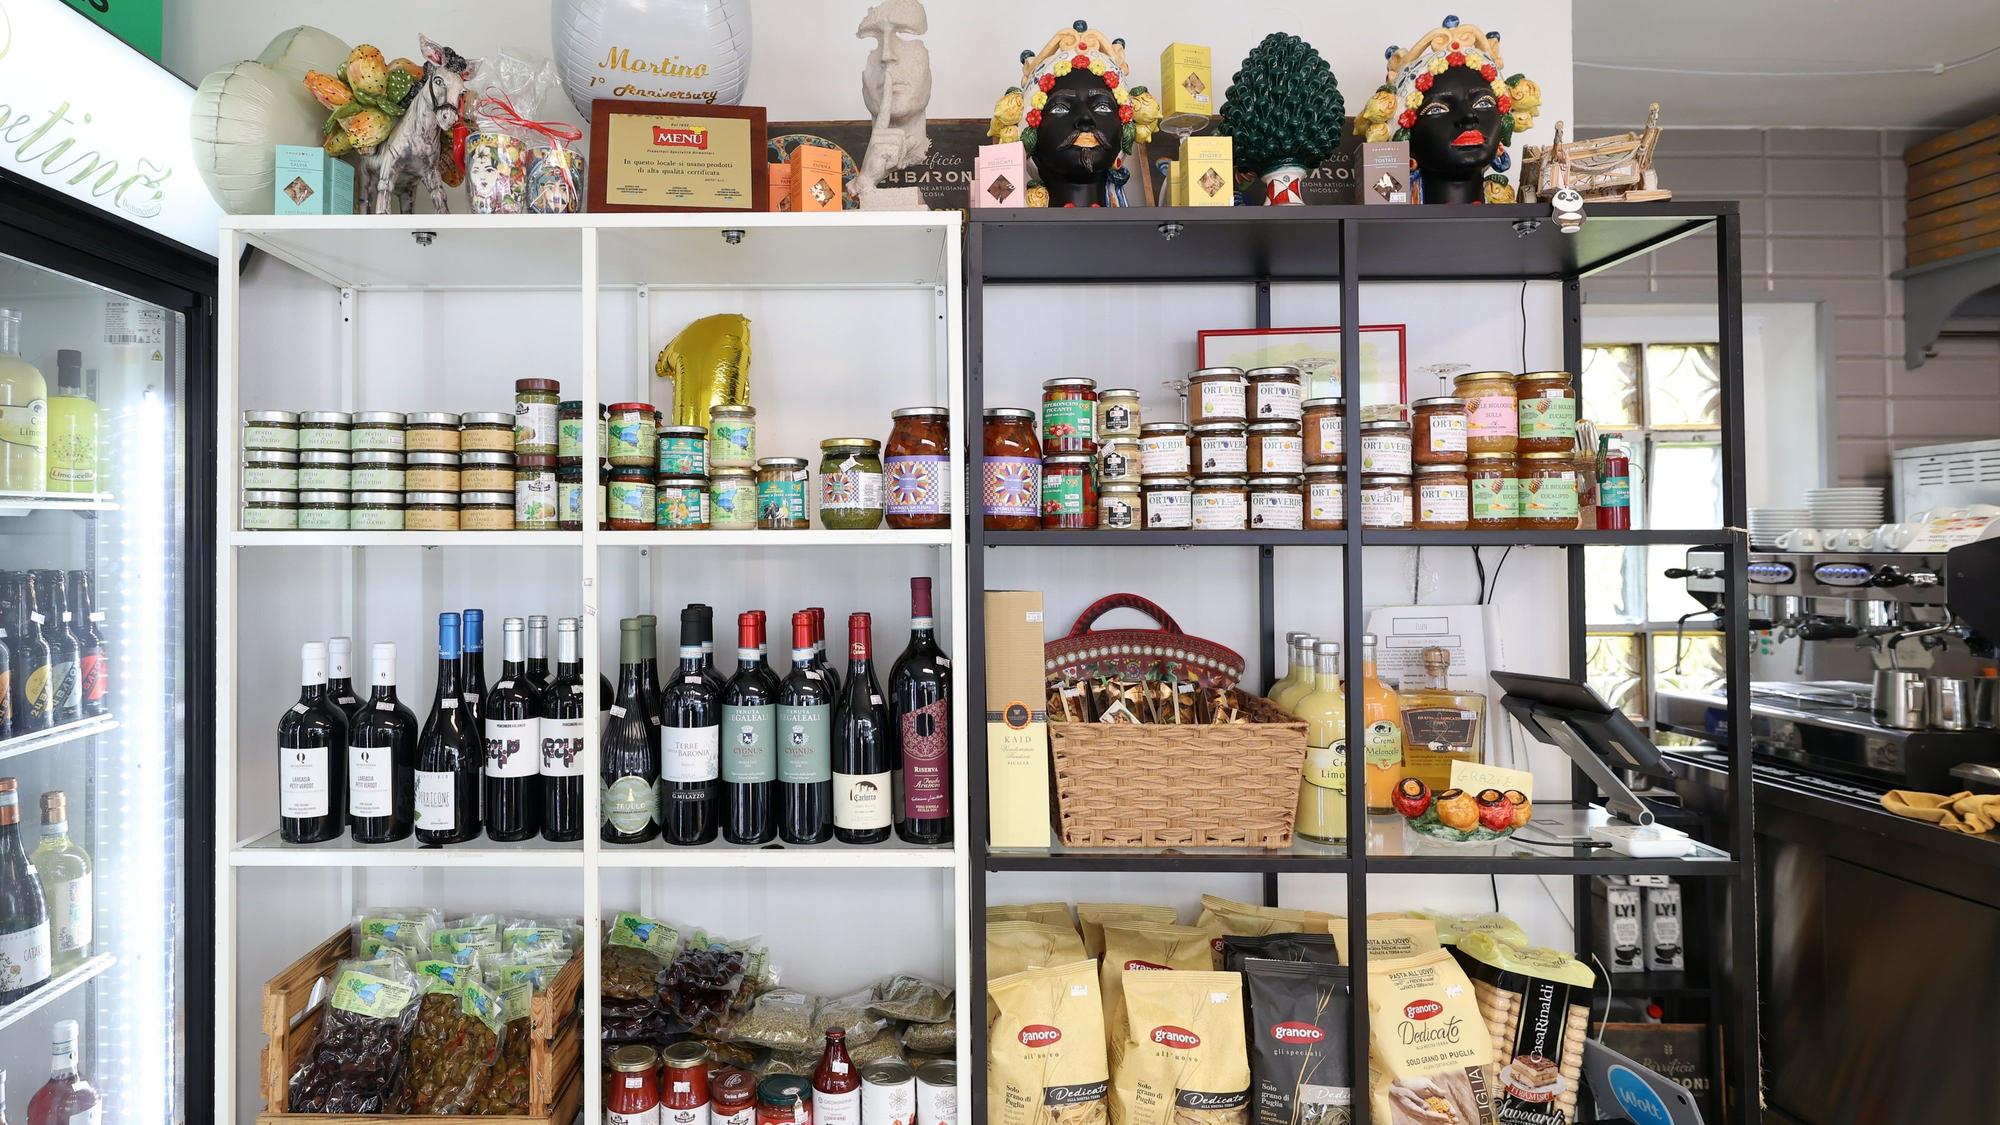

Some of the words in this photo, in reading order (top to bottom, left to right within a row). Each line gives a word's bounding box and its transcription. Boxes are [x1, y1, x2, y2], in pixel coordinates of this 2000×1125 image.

[598, 46, 708, 78] Martino
[614, 84, 718, 104] Anniversary
[905, 171, 972, 182] BARON
[1310, 168, 1356, 180] ARO
[1140, 440, 1184, 452] RTOVERDE
[1004, 735, 1032, 744] KAID
[296, 752, 306, 764] Q
[361, 752, 370, 763] Q
[1321, 770, 1346, 778] Limo
[1615, 904, 1636, 917] LY!
[1655, 904, 1676, 916] LY!
[1408, 968, 1434, 977] ALL'UOVO
[1406, 1004, 1438, 1018] granoro
[1530, 984, 1554, 1064] CasaRinaldi
[1274, 1026, 1324, 1040] granoro
[1398, 1016, 1463, 1045] Dedicato
[1155, 1030, 1199, 1044] granoro
[1406, 1058, 1420, 1066] SOLO
[1422, 1054, 1439, 1064] GRANO
[1450, 1049, 1475, 1059] PUGLIA
[1006, 1084, 1020, 1094] Solo
[1137, 1082, 1152, 1090] Solo
[1262, 1083, 1277, 1092] Solo
[1671, 1078, 1710, 1090] RONI
[1006, 1092, 1024, 1101] grano
[1050, 1084, 1108, 1100] Dedicato
[1136, 1089, 1156, 1098] grano
[1262, 1092, 1282, 1100] grano
[1006, 1098, 1024, 1108] Puglia
[1136, 1094, 1156, 1106] Puglia
[1184, 1092, 1245, 1105] Dedicato
[1261, 1098, 1283, 1108] Puglia
[1618, 1087, 1662, 1120] Wolt
[1495, 1098, 1566, 1125] Savoiardi
